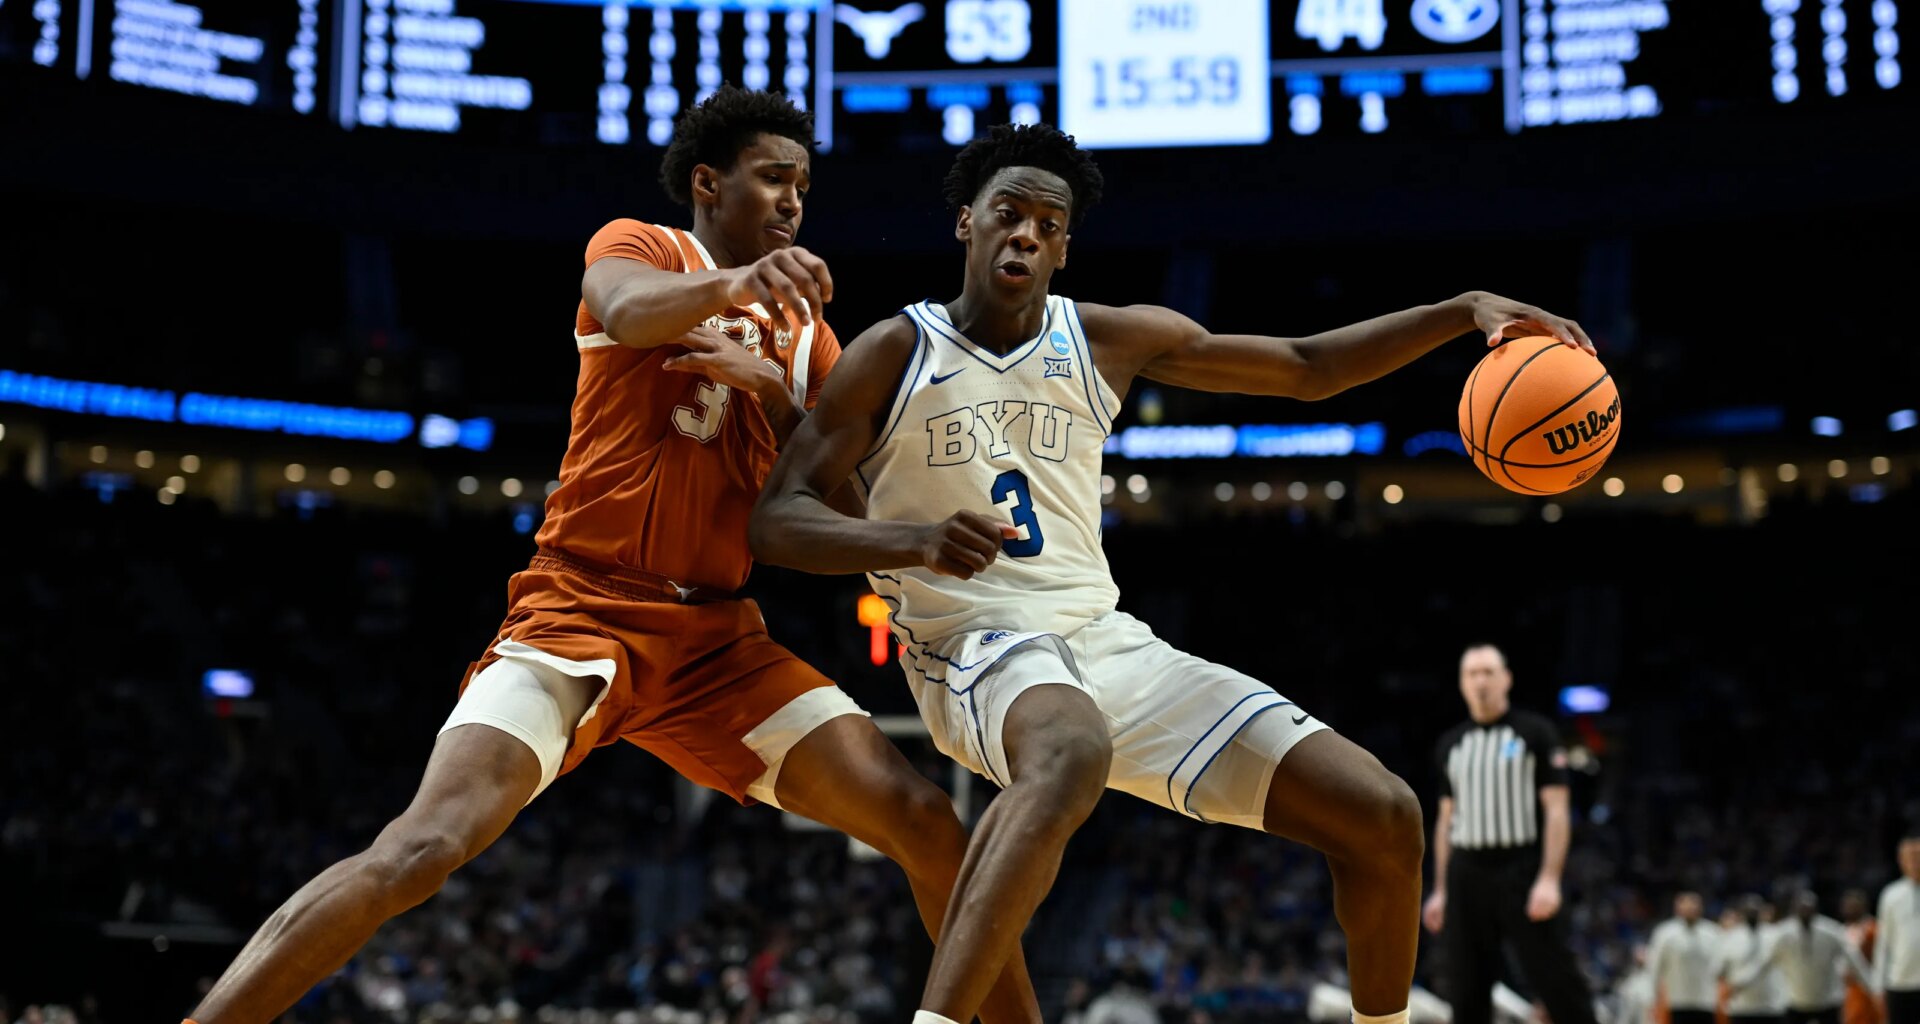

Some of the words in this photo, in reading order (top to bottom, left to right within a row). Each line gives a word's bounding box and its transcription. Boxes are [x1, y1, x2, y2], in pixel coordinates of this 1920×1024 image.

[946, 0, 1030, 61] 53
[1090, 57, 1240, 109] 15:59
[671, 381, 731, 444] 3
[926, 400, 1073, 467] BYU
[1542, 395, 1620, 455] Wilson
[990, 469, 1044, 557] 3
